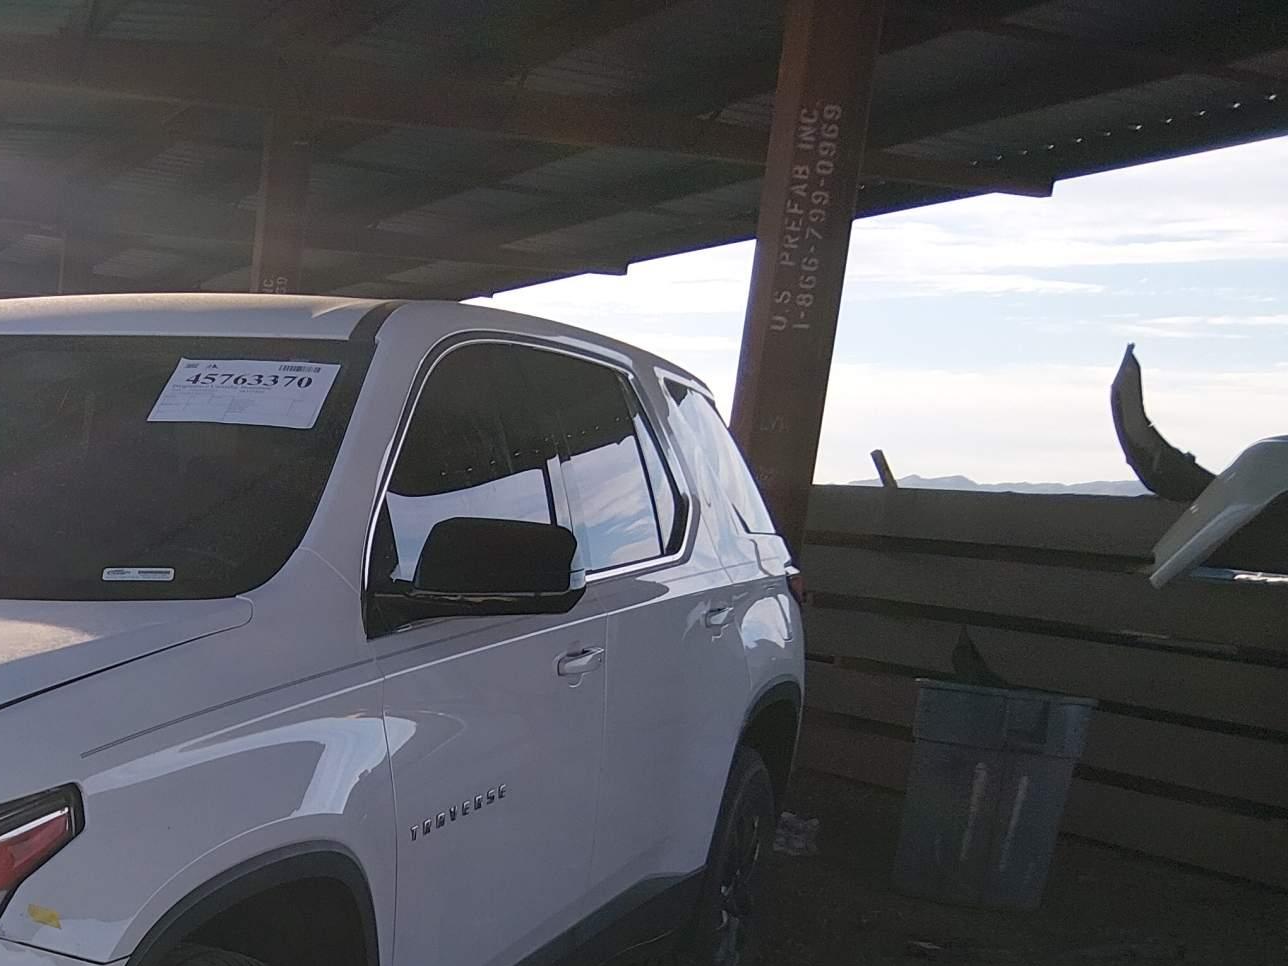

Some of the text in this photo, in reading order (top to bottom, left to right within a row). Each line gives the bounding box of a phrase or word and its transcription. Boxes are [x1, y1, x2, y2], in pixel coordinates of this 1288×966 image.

[780, 164, 810, 266] PREFAB
[792, 103, 843, 330] 1-866-799-0969
[185, 372, 313, 389] 45763370
[410, 784, 507, 841] TRAVERSE
